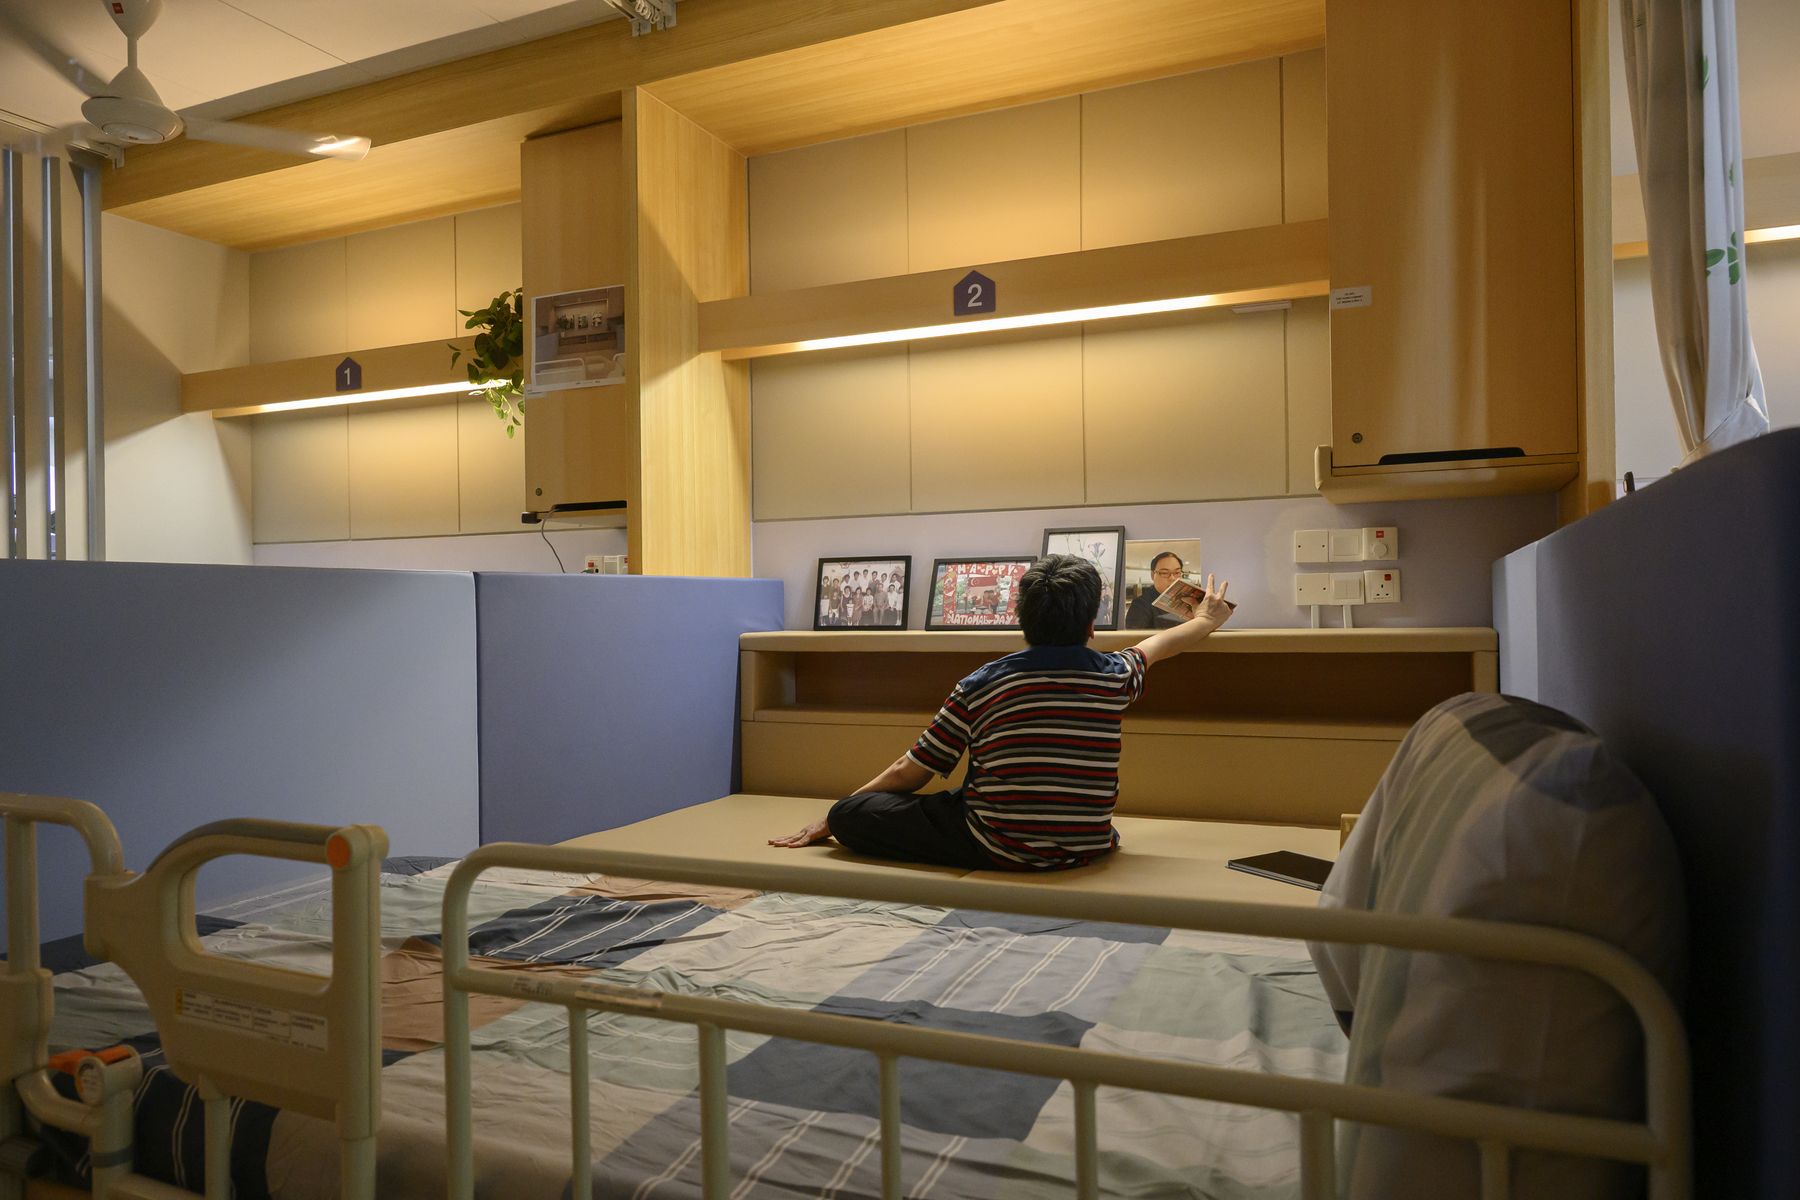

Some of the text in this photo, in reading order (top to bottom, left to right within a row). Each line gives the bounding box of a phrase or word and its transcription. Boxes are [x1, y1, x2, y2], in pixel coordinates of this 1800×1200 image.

[967, 283, 982, 307] 2
[343, 367, 350, 385] 1
[957, 563, 1015, 576] HAPPY
[947, 613, 1014, 625] NATIONAL DAY
